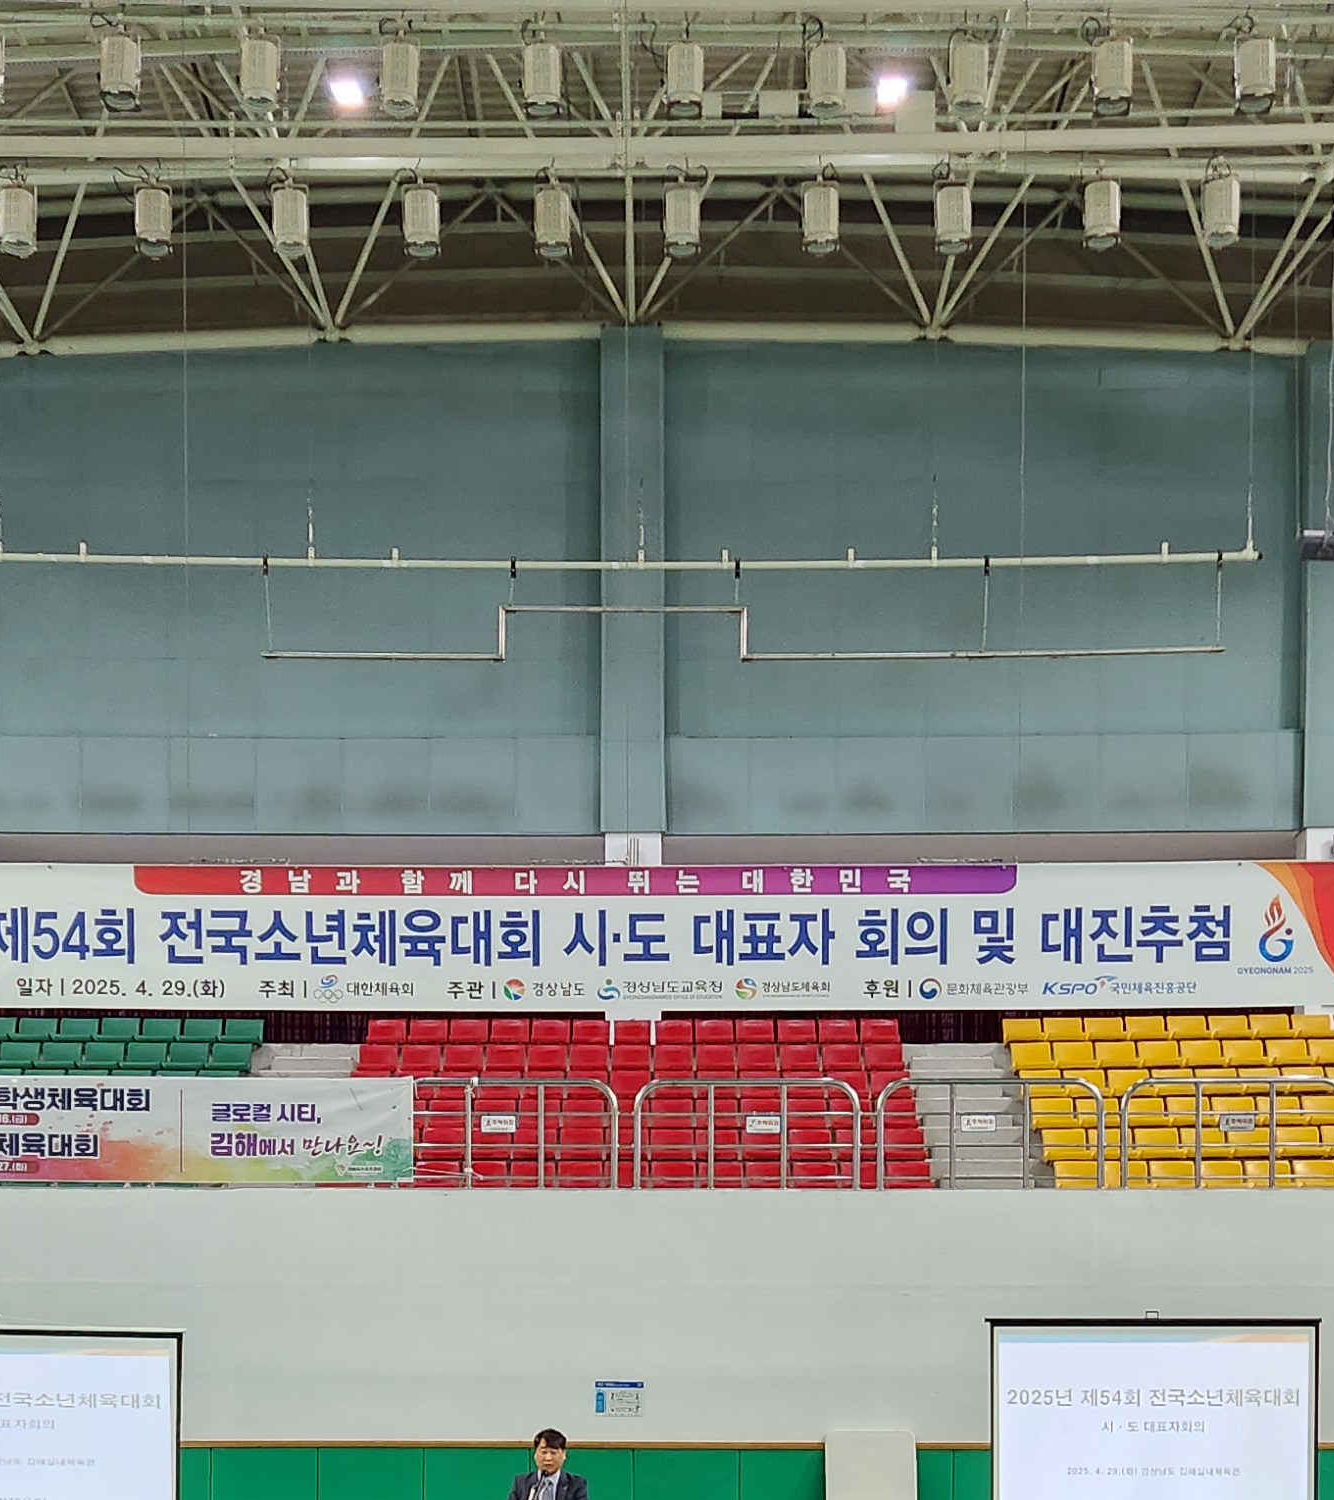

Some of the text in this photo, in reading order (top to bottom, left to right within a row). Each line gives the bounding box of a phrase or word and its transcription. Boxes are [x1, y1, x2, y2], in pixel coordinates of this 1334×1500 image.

[239, 868, 912, 895] 경남과 함께 다시 뛰는 대한민국
[158, 907, 541, 967] 전국소년체육대회
[563, 908, 671, 967] 시·도
[692, 908, 836, 967] 대표자
[854, 907, 949, 966] 회의
[972, 907, 1016, 965] 및
[1040, 904, 1232, 965] 대진추첨
[1237, 966, 1314, 975] GYEONGNAM 2025
[16, 978, 226, 998] 일자 2025. 4. 29.(화)
[258, 979, 295, 999] 주최
[346, 981, 415, 998] 대한체육회
[446, 980, 485, 1000] 주관
[531, 981, 586, 998] 경상남도
[622, 979, 724, 994] 경상남도교육청
[761, 981, 831, 993] 경상남도체육회
[862, 979, 900, 999] 후원
[945, 981, 1029, 996] 문화체육관광부
[1041, 981, 1098, 996] KSPO
[1109, 981, 1197, 995] 국민체육진흥공단
[211, 1102, 322, 1124] 글로컬 시티,
[210, 1132, 295, 1156] 김해에서
[1006, 1387, 1302, 1408] 2025년 제54회 전국소년체육대회
[1101, 1420, 1115, 1434] 시
[1126, 1420, 1140, 1433] 도
[1143, 1420, 1206, 1434] 대표자회의
